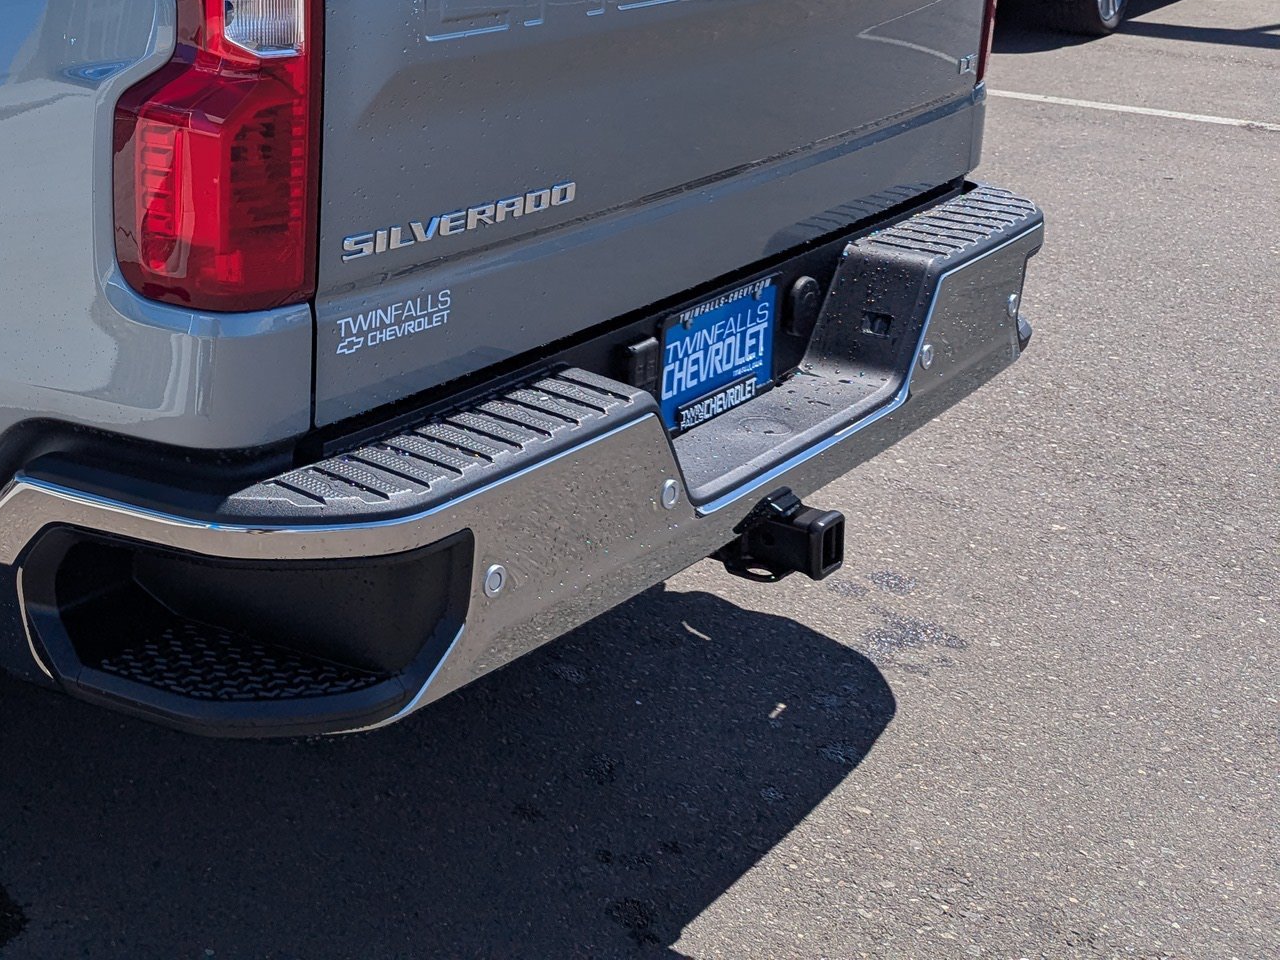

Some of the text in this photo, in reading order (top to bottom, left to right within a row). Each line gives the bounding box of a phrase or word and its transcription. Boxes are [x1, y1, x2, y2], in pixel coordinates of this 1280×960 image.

[341, 181, 577, 263] SILVERADO
[337, 290, 451, 337] TWINFALLS
[680, 278, 771, 323] TWINFALLS-CHEVY.COM
[368, 310, 451, 346] CHEVROLET
[666, 302, 769, 363] TWINFALLS
[661, 322, 768, 401] CHEVROLET
[680, 402, 704, 421] TWIN
[703, 377, 758, 419] CHEVROLET
[680, 412, 704, 430] FALLS
